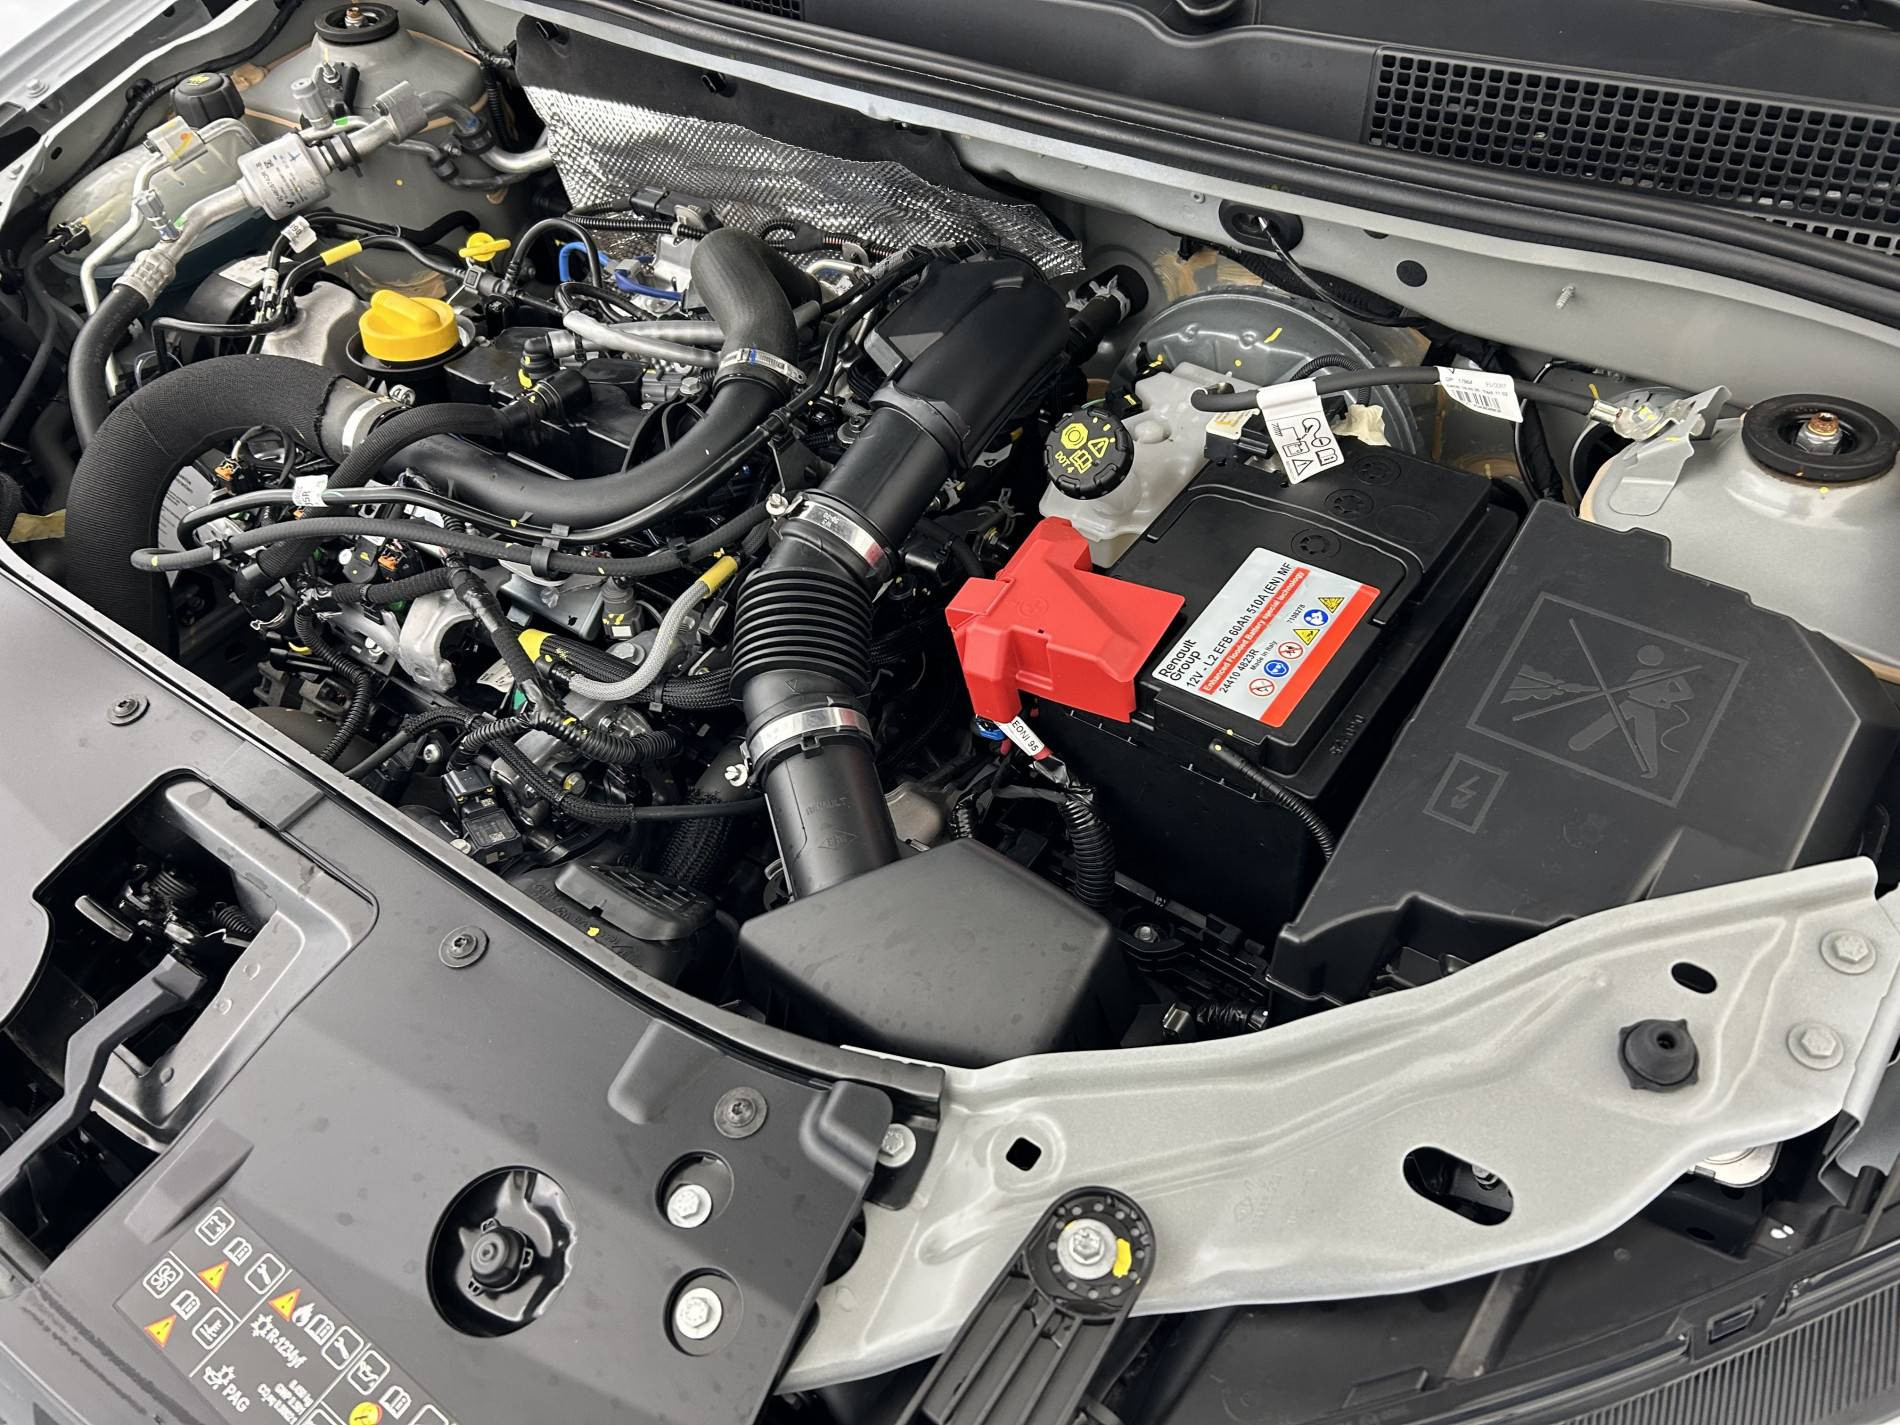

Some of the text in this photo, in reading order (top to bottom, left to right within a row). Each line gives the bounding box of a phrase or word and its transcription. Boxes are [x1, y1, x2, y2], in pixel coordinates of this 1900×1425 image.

[1055, 450, 1075, 474] DOT 4
[1186, 671, 1203, 687] 12V
[1203, 654, 1219, 667] L2
[1213, 636, 1233, 654] EFB
[1229, 614, 1252, 636] 60Ah
[1247, 594, 1269, 614] 510A
[1264, 576, 1285, 595] (EN)
[1277, 562, 1292, 576] MF
[1203, 571, 1305, 691] Enhanced Flooded Battery special technology
[1158, 639, 1197, 678] Renault
[1170, 651, 1201, 681] Group
[1219, 648, 1260, 693] 24410 4823R
[1250, 658, 1263, 671] Made
[1265, 640, 1278, 653] Italy
[1011, 720, 1039, 751] EONI 95
[265, 1328, 307, 1368] R-1234yf
[222, 1383, 250, 1412] PAG
